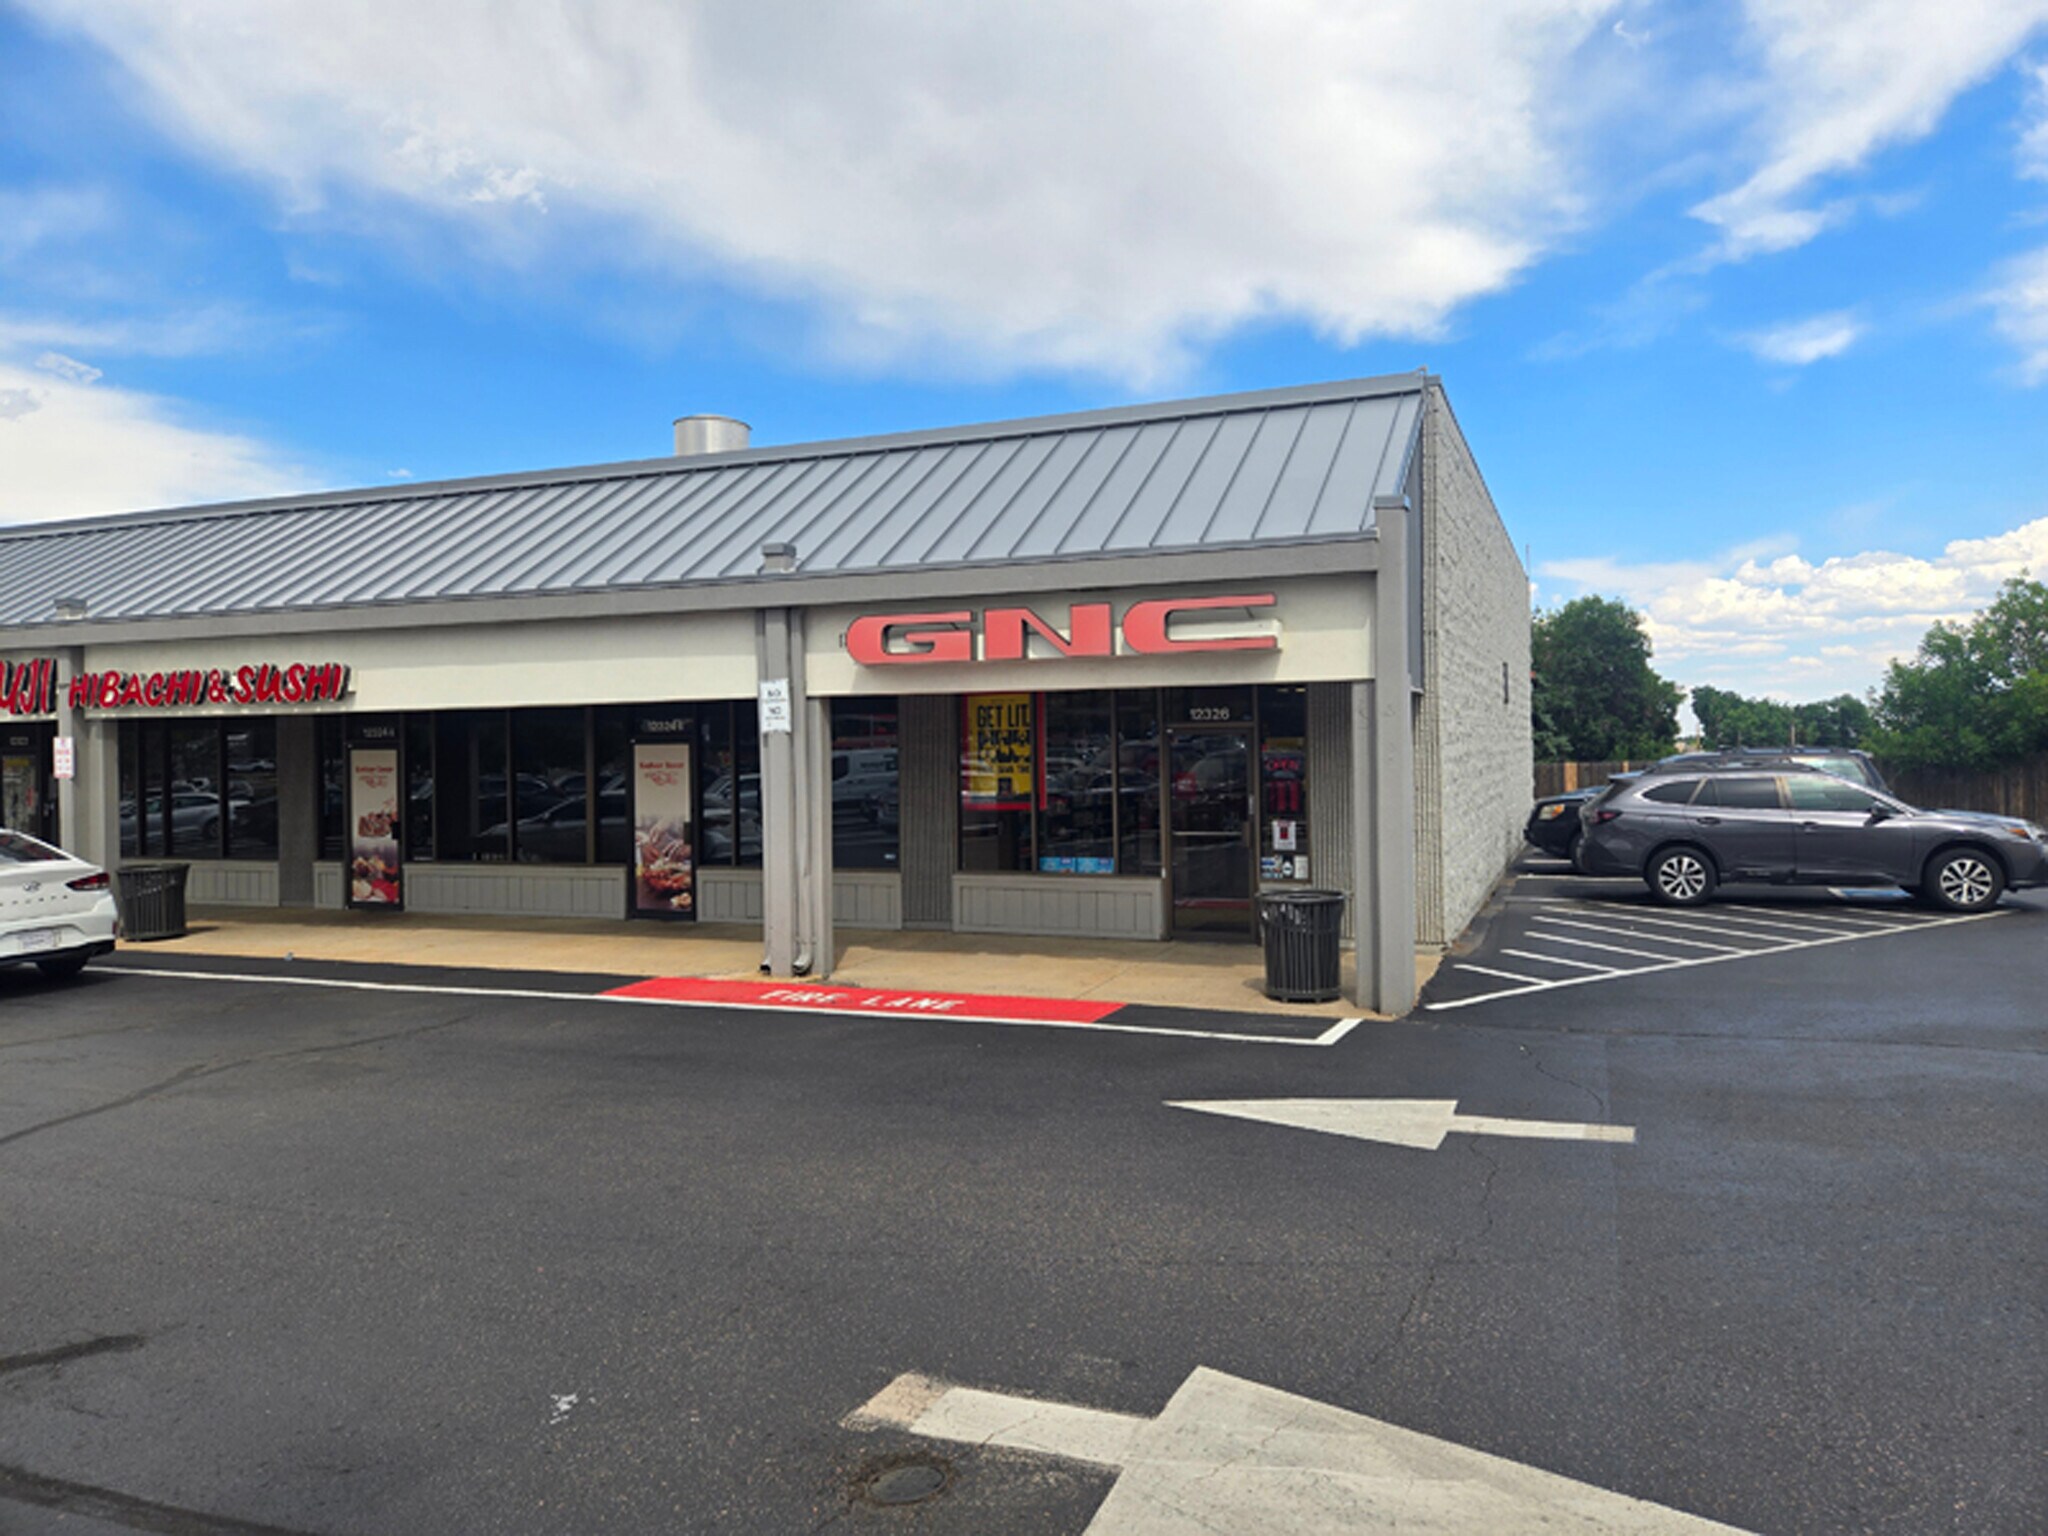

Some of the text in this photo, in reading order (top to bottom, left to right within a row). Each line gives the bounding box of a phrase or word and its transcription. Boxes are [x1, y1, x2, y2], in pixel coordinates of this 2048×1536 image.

[846, 594, 1278, 664] GNC
[68, 663, 343, 708] HIBACHI & SUSHI
[977, 704, 1002, 727] GET
[758, 989, 966, 1010] FIRE LANE
